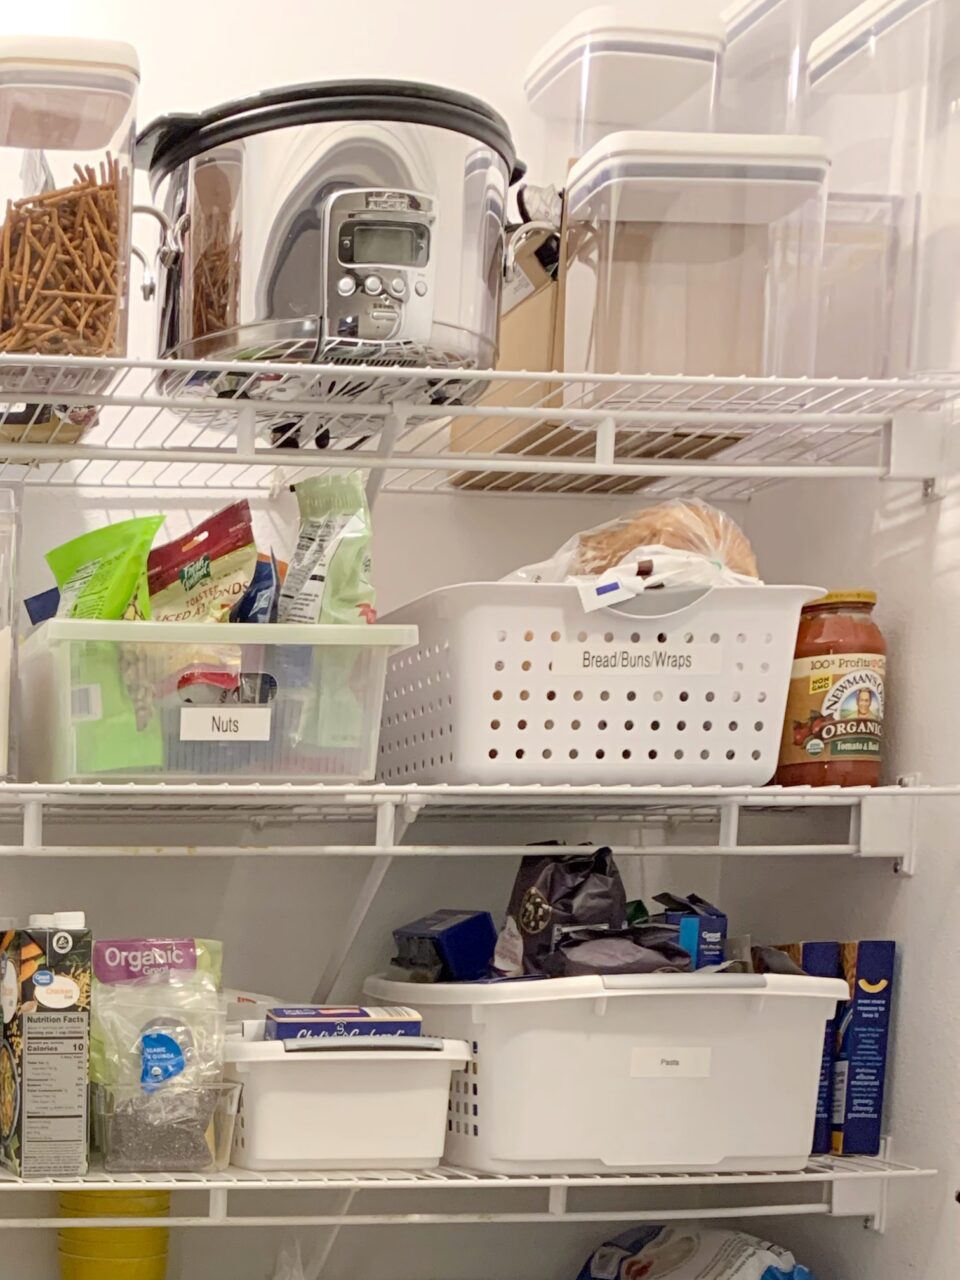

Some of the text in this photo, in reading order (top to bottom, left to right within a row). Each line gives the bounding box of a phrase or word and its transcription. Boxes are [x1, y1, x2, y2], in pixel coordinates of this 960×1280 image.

[582, 651, 692, 669] Bread/Buns/Wraps
[812, 683, 830, 691] GMO
[211, 715, 239, 733] Nuts
[837, 741, 863, 751] Tomato
[105, 946, 184, 972] Organic
[27, 1015, 84, 1023] Nutrition Facts
[27, 1043, 84, 1052] Calories 10
[661, 1058, 679, 1067] Pasta
